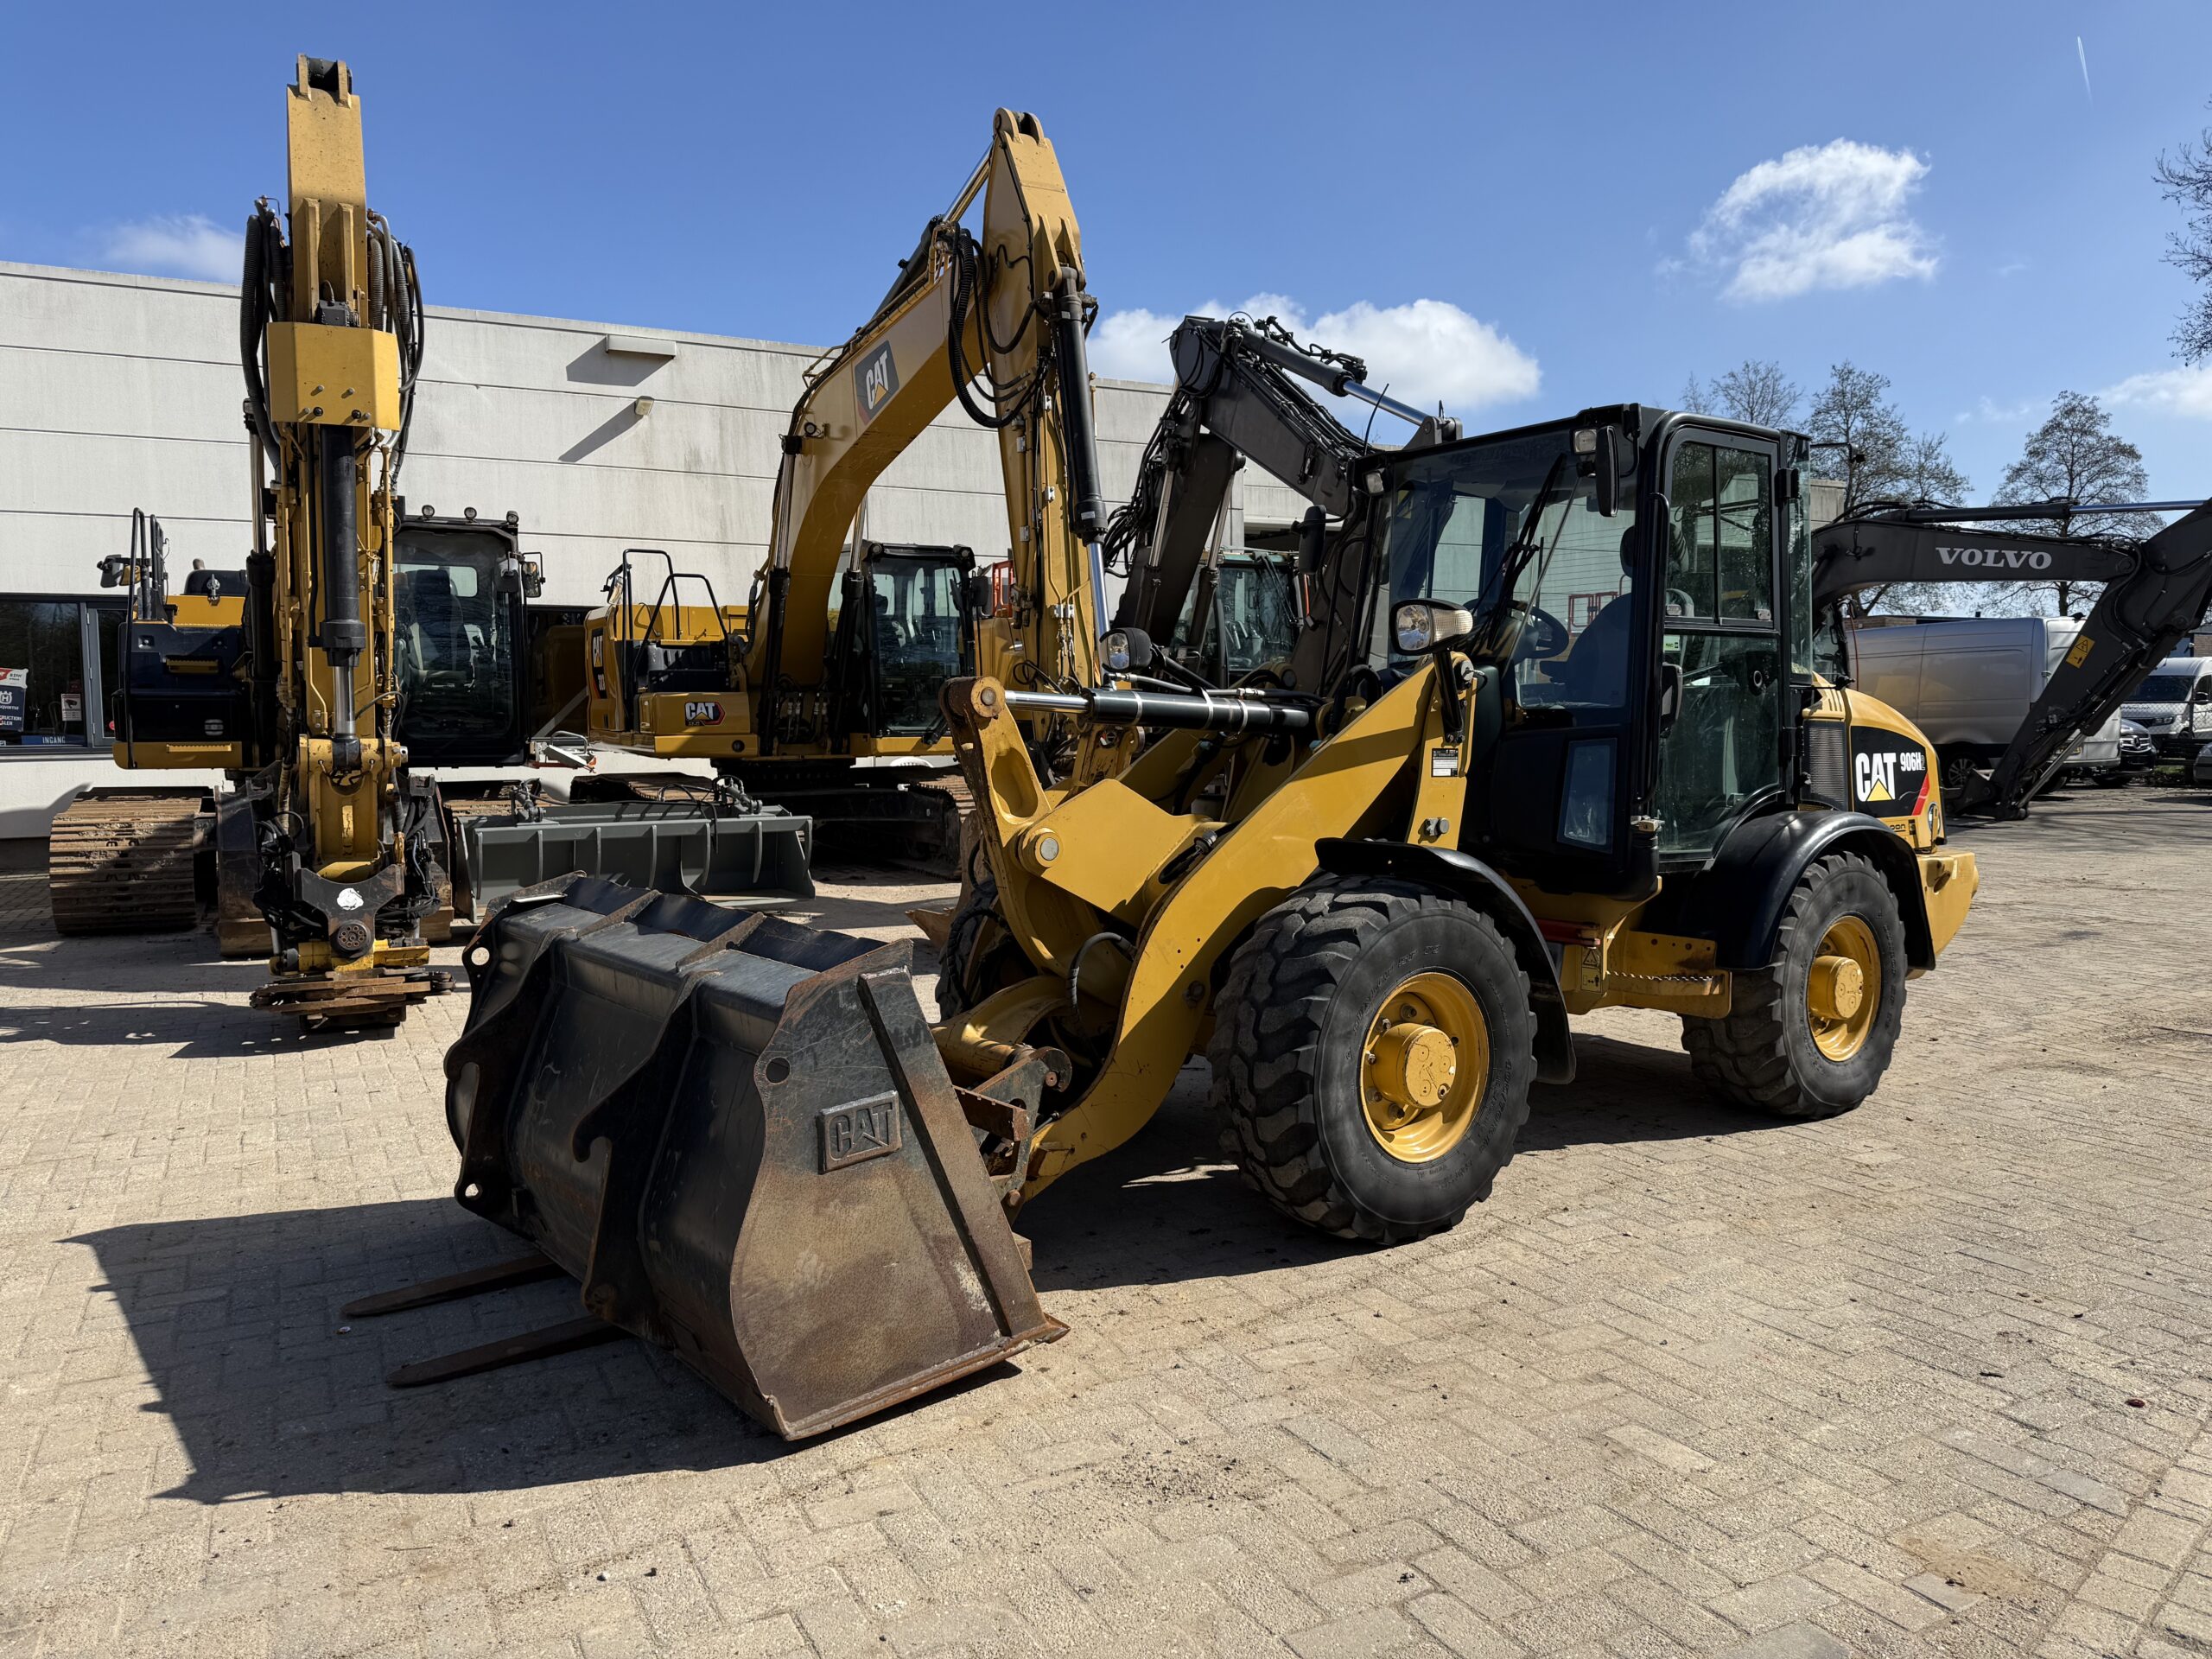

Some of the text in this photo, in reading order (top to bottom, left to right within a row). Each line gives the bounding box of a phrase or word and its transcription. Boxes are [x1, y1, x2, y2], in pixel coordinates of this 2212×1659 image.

[866, 350, 888, 410] CAT
[1936, 547, 2052, 569] VOLVO
[685, 702, 715, 721] CAT
[1855, 753, 1897, 802] CAT
[829, 1102, 893, 1160] CAT
